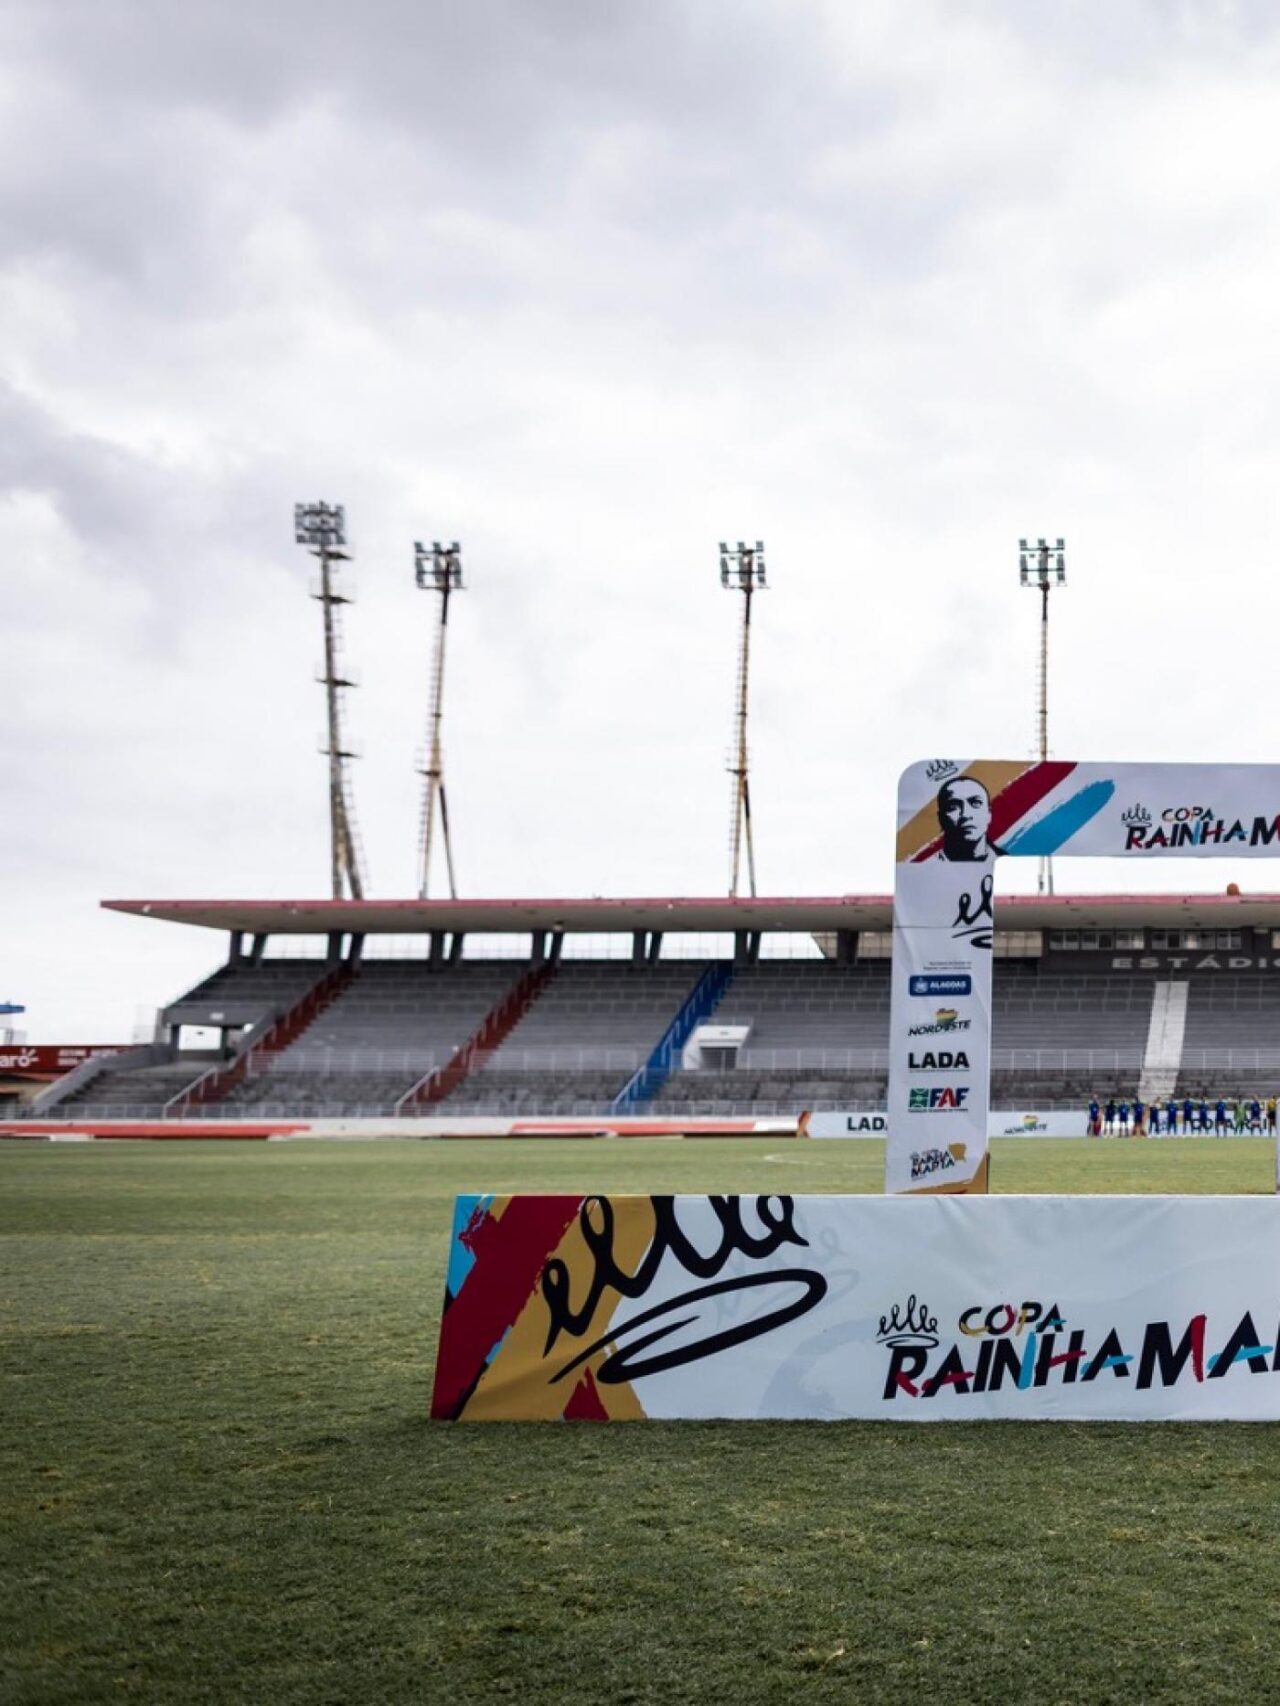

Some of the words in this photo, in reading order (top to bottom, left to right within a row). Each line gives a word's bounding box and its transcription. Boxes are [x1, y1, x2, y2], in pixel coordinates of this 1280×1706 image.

[1161, 806, 1214, 822] COPA
[908, 1051, 970, 1069] LADA
[929, 1087, 970, 1108] FAF
[847, 1116, 888, 1131] LAD
[959, 1301, 1067, 1336] COPA
